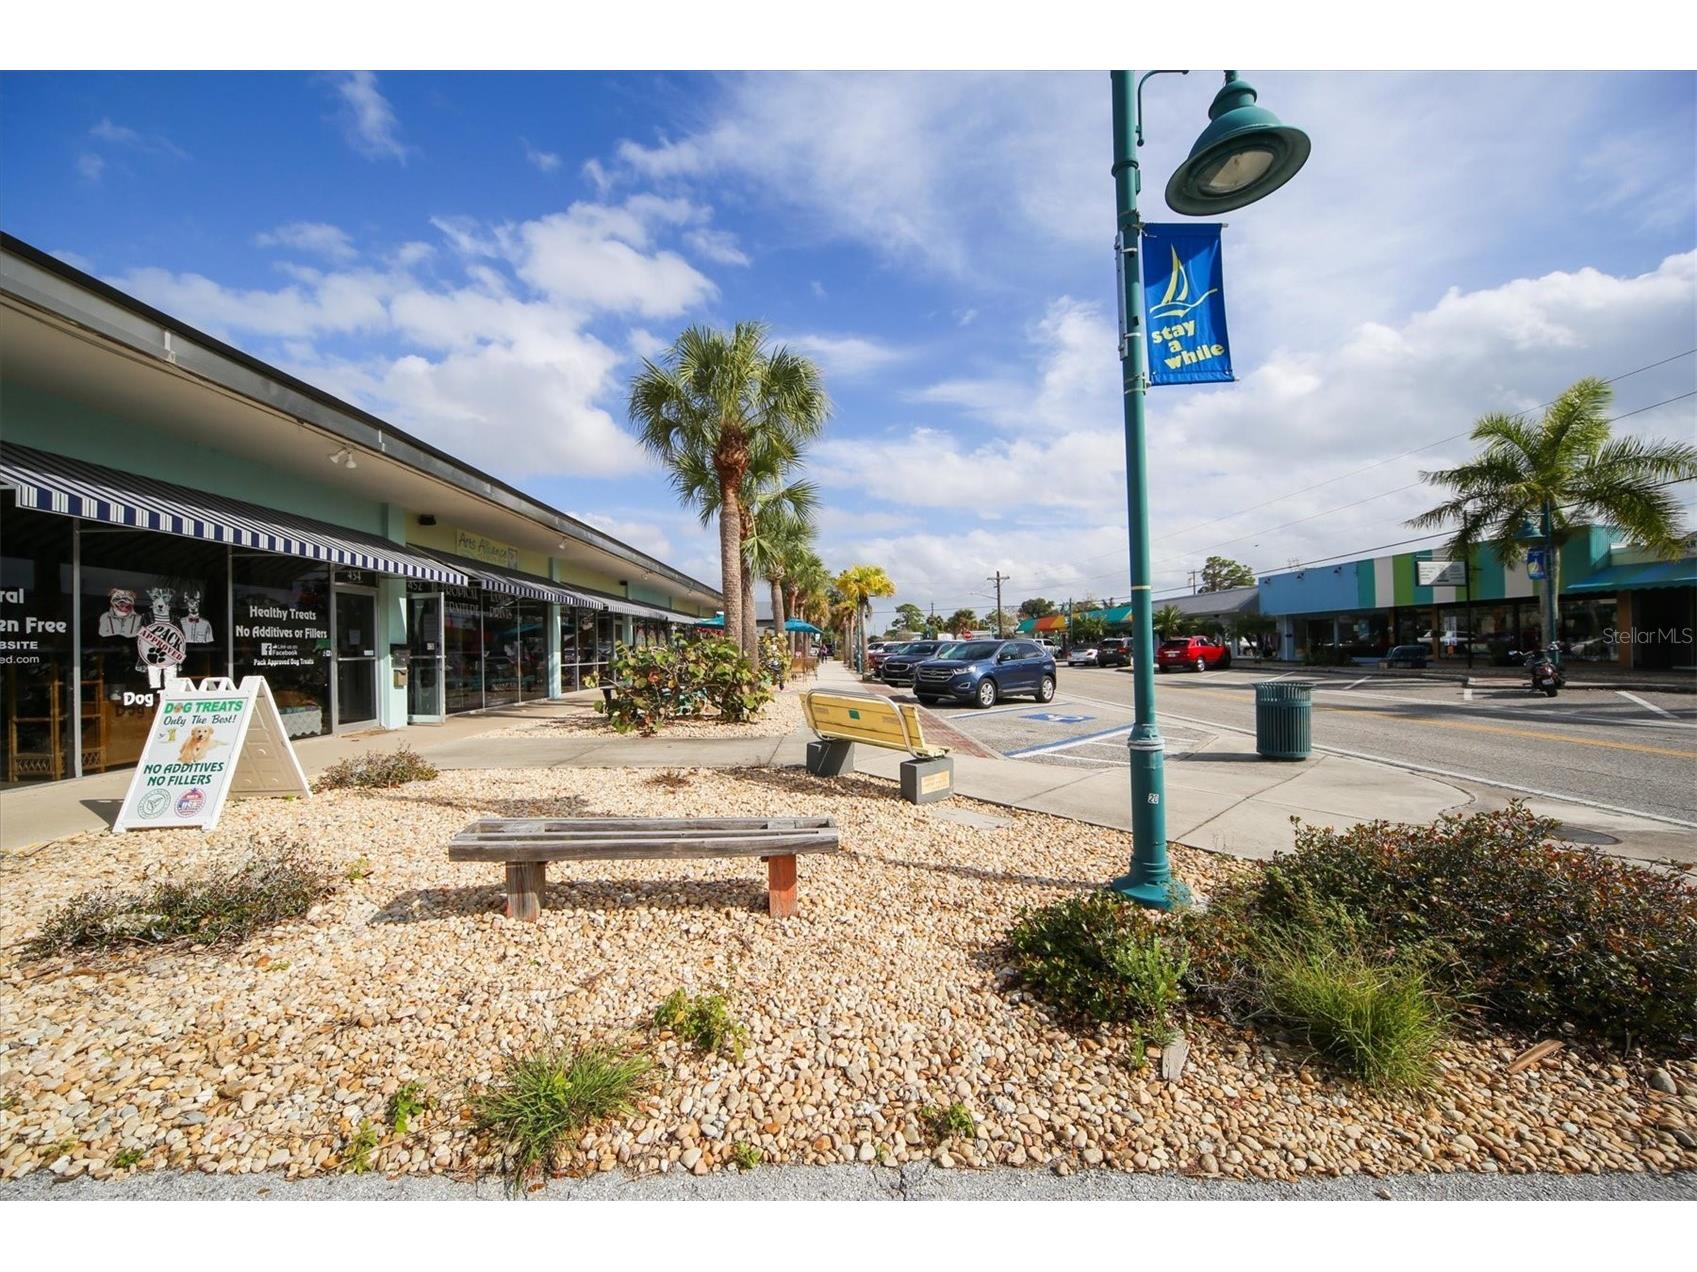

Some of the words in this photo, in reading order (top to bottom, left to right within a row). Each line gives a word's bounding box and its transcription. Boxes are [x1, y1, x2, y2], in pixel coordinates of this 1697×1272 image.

[1152, 320, 1195, 344] stay
[1168, 340, 1182, 352] a
[1164, 343, 1225, 369] while
[0, 588, 24, 604] ral
[249, 605, 288, 621] Healthy
[289, 608, 317, 620] Treats
[0, 620, 19, 632] en
[26, 616, 67, 634] Free
[235, 625, 250, 637] No
[252, 625, 293, 638] Additives
[294, 629, 303, 638] or
[304, 628, 328, 639] Fillers
[140, 630, 183, 661] APPROVED
[152, 625, 182, 651] PACK
[253, 658, 266, 666] Pack
[123, 692, 154, 707] Dog
[195, 701, 243, 713] TREATS
[163, 715, 187, 727] Only
[191, 715, 207, 724] The
[211, 714, 237, 724] Best!
[143, 764, 162, 774] NO
[163, 762, 224, 774] ADDITIVES
[147, 776, 165, 786] NO
[167, 774, 212, 786] FILLERS
